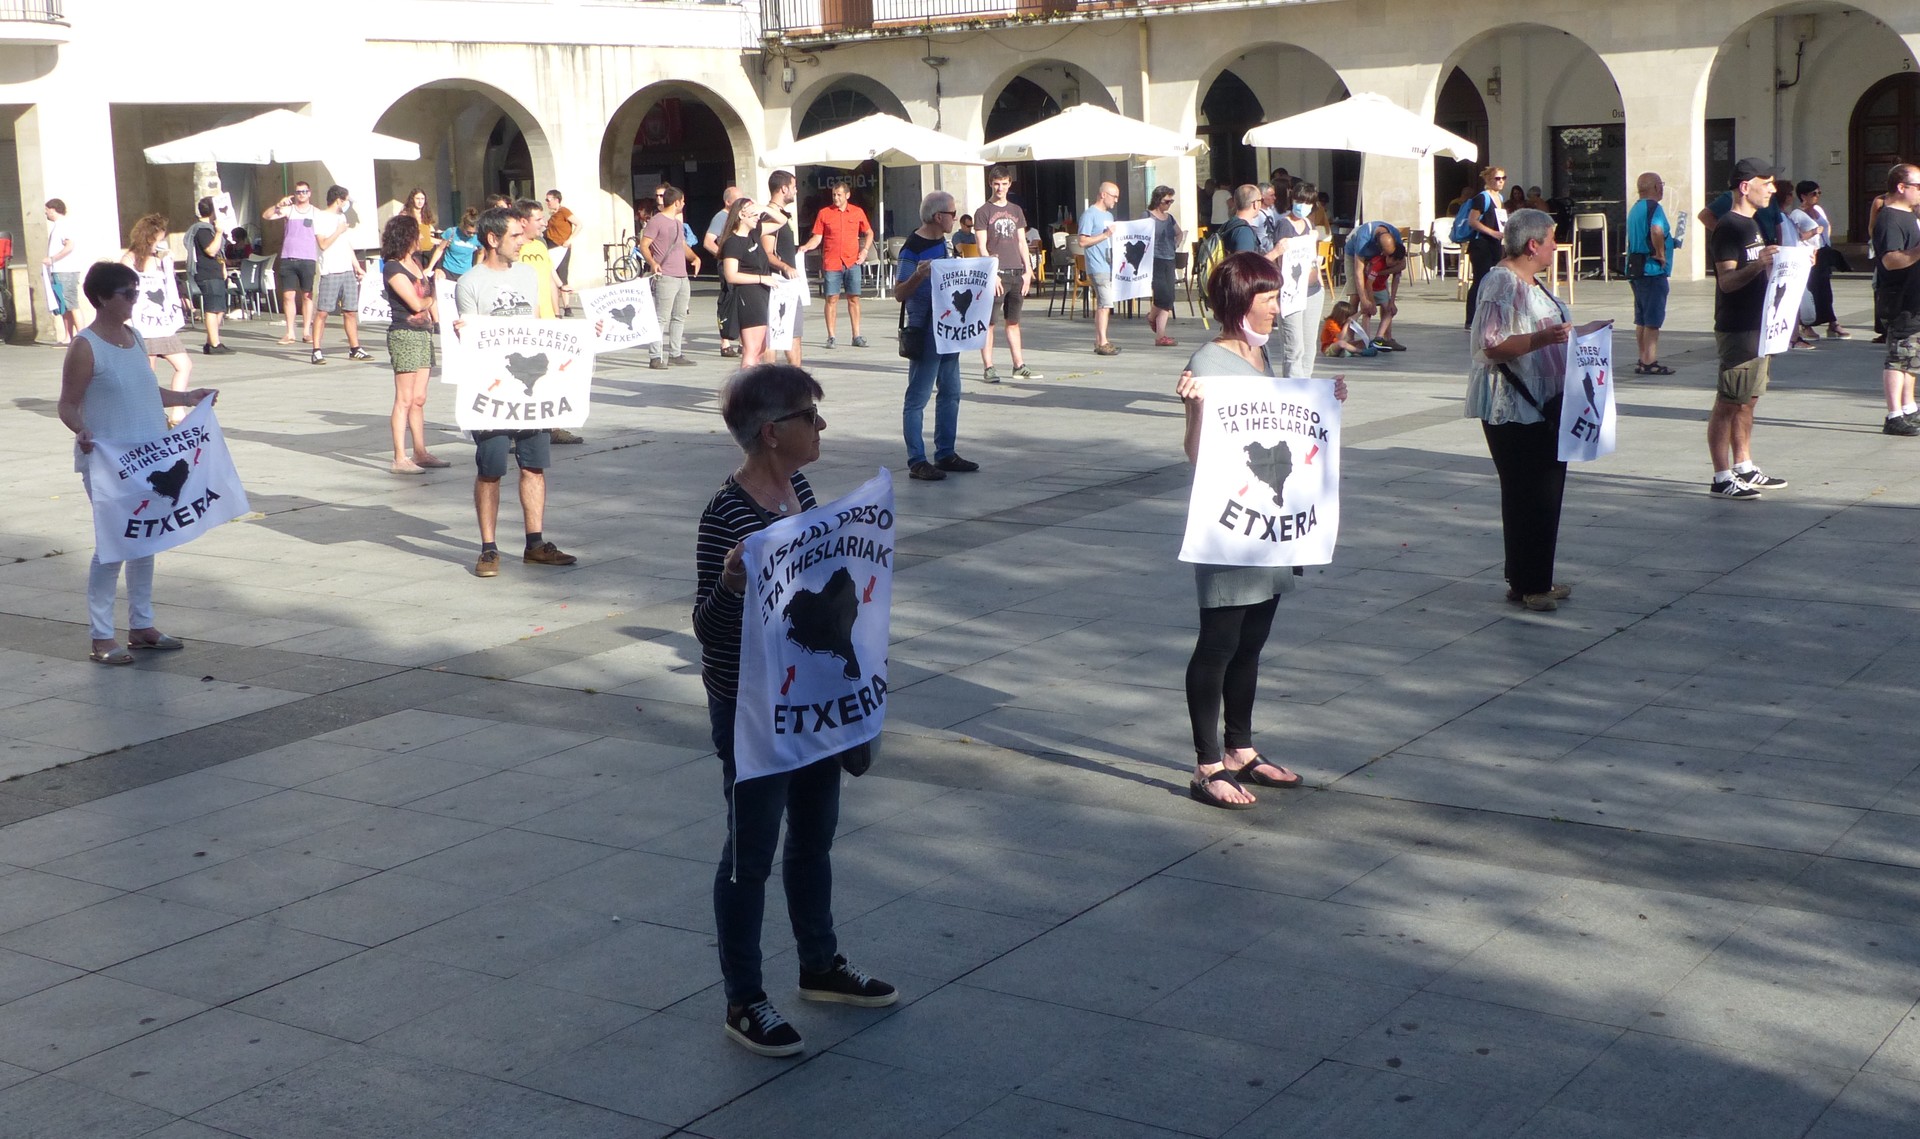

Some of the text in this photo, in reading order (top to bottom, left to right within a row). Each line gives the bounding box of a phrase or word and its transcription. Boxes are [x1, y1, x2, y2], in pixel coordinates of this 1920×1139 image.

[1902, 58, 1910, 70] 5
[940, 280, 951, 291] ETA
[942, 269, 988, 282] EUSKAL PRESO
[362, 305, 393, 318] ETXE
[480, 327, 578, 345] EUSKAL PRESO
[936, 319, 987, 341] ETXERA
[477, 336, 583, 356] ETA IHESLARIAK
[472, 393, 573, 421] ETXERA
[1217, 401, 1321, 424] EUSKAL PRESO
[1223, 417, 1329, 443] TA IHESLARIAK
[119, 425, 205, 467] EUSKAL PRES
[118, 462, 139, 480] ETA
[124, 487, 221, 539] ETXERA
[1218, 498, 1318, 543] ETXERA
[757, 504, 894, 596] EUSKAL PRESO
[785, 535, 893, 585] IHESLARIAK
[774, 673, 888, 735] ETXERA
